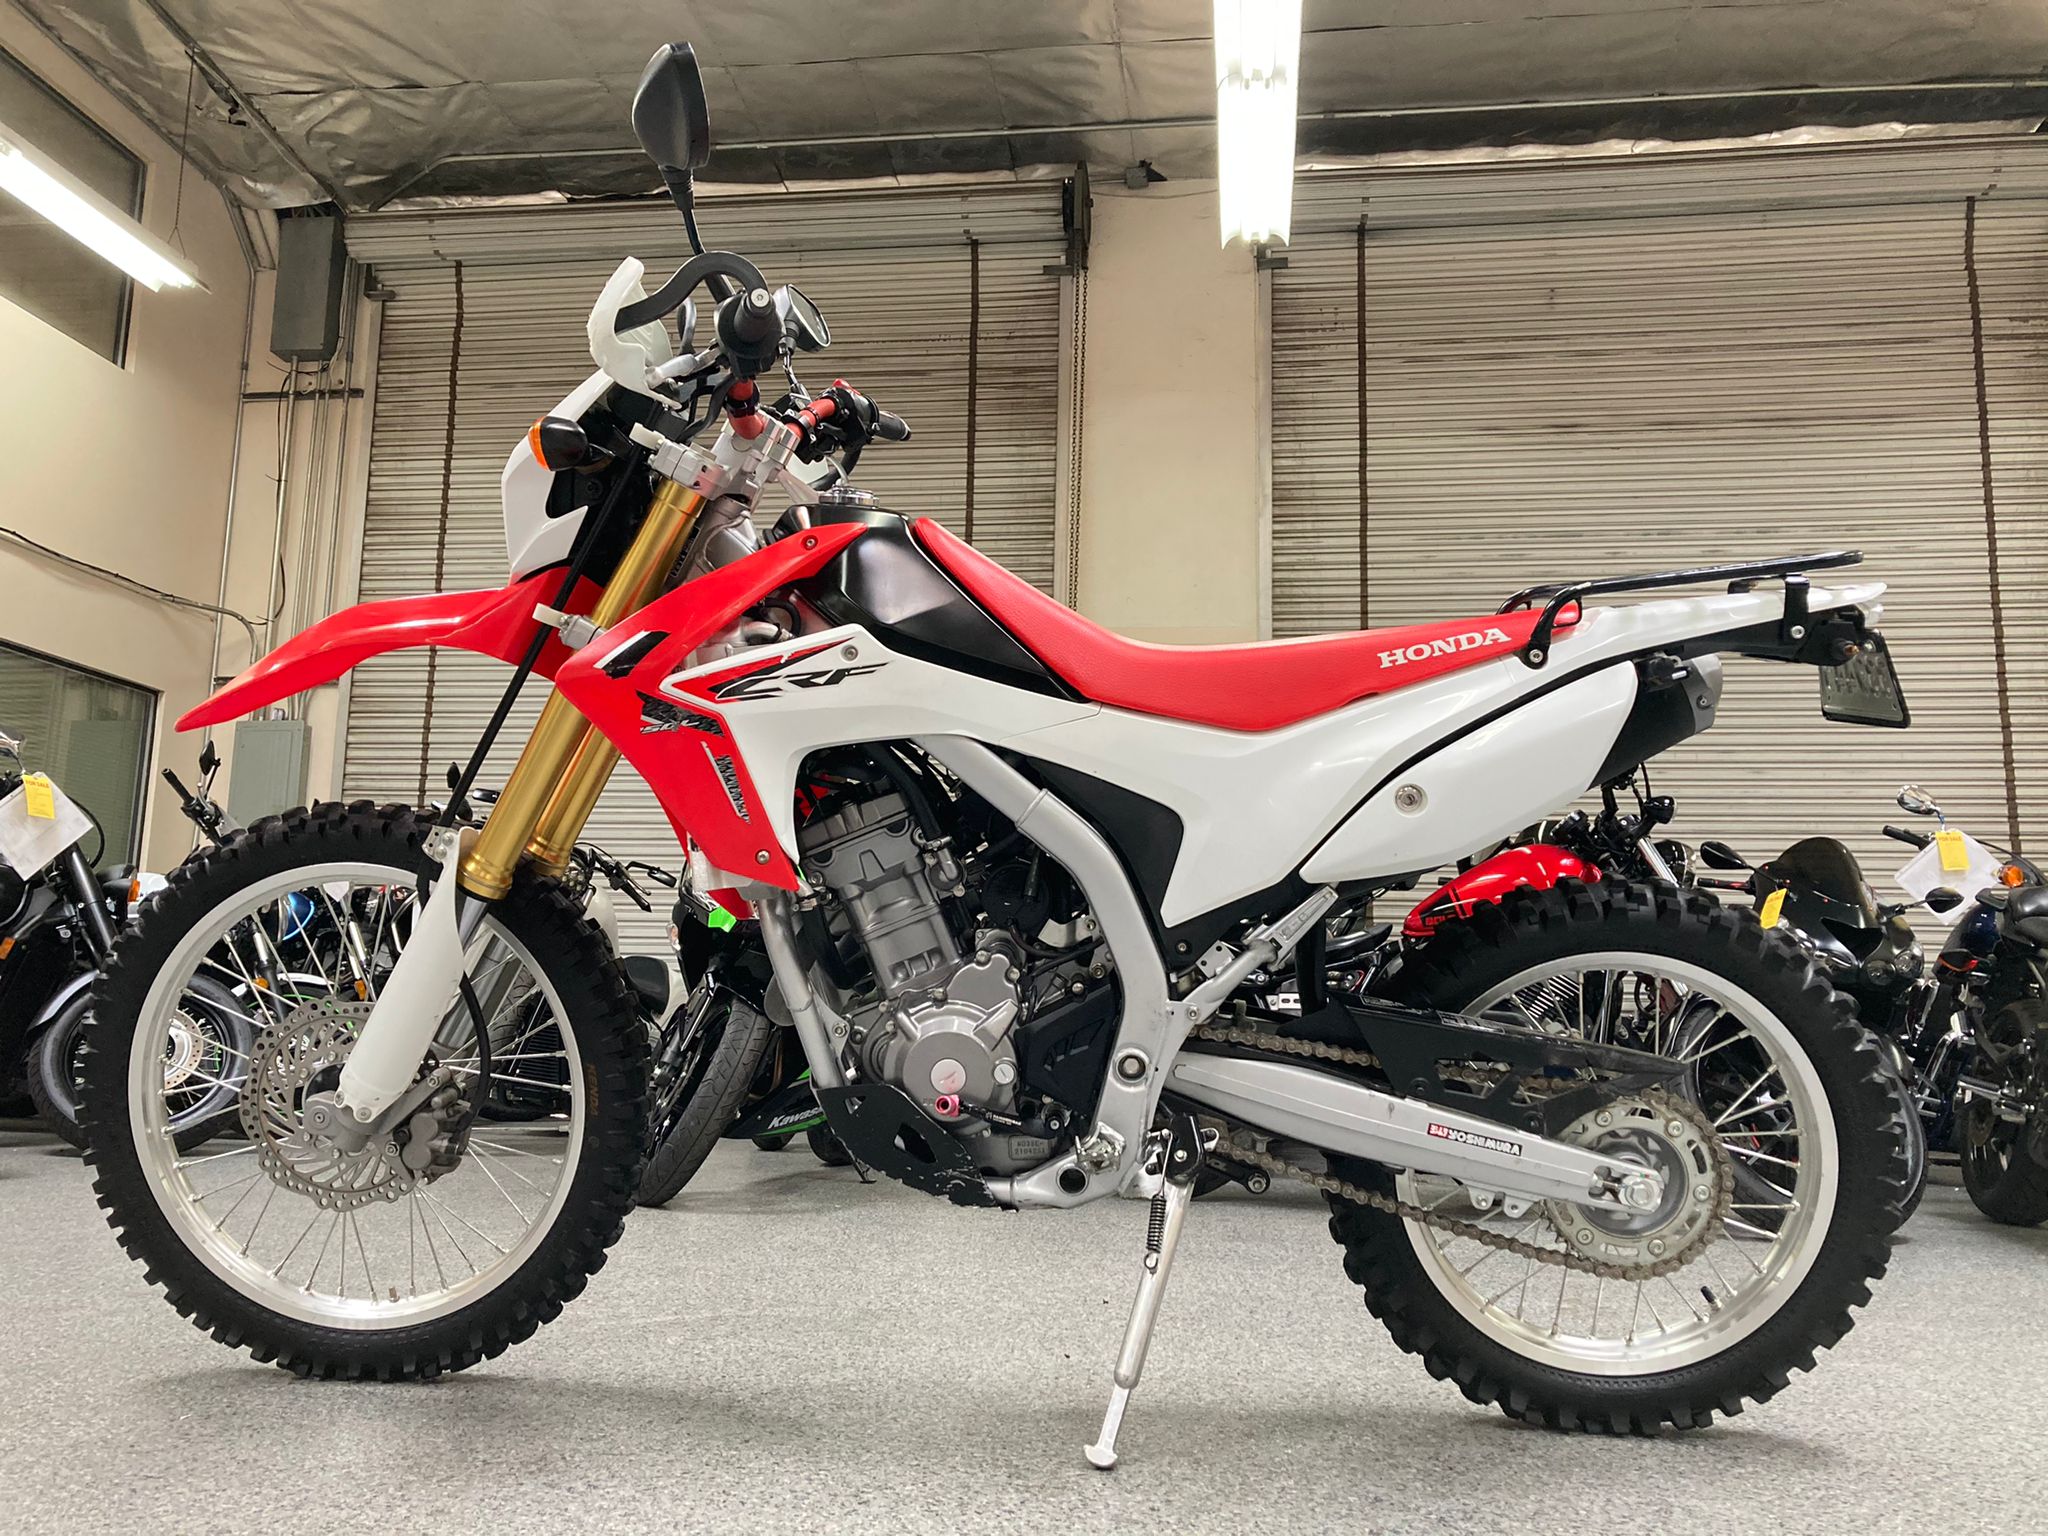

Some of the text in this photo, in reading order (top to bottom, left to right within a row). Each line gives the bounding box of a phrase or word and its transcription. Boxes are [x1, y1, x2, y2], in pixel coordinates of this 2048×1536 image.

[1377, 628, 1512, 668] HONDA
[716, 660, 893, 699] CRF
[767, 1106, 824, 1130] Kawas
[1448, 1129, 1520, 1155] YOSHIMURA
